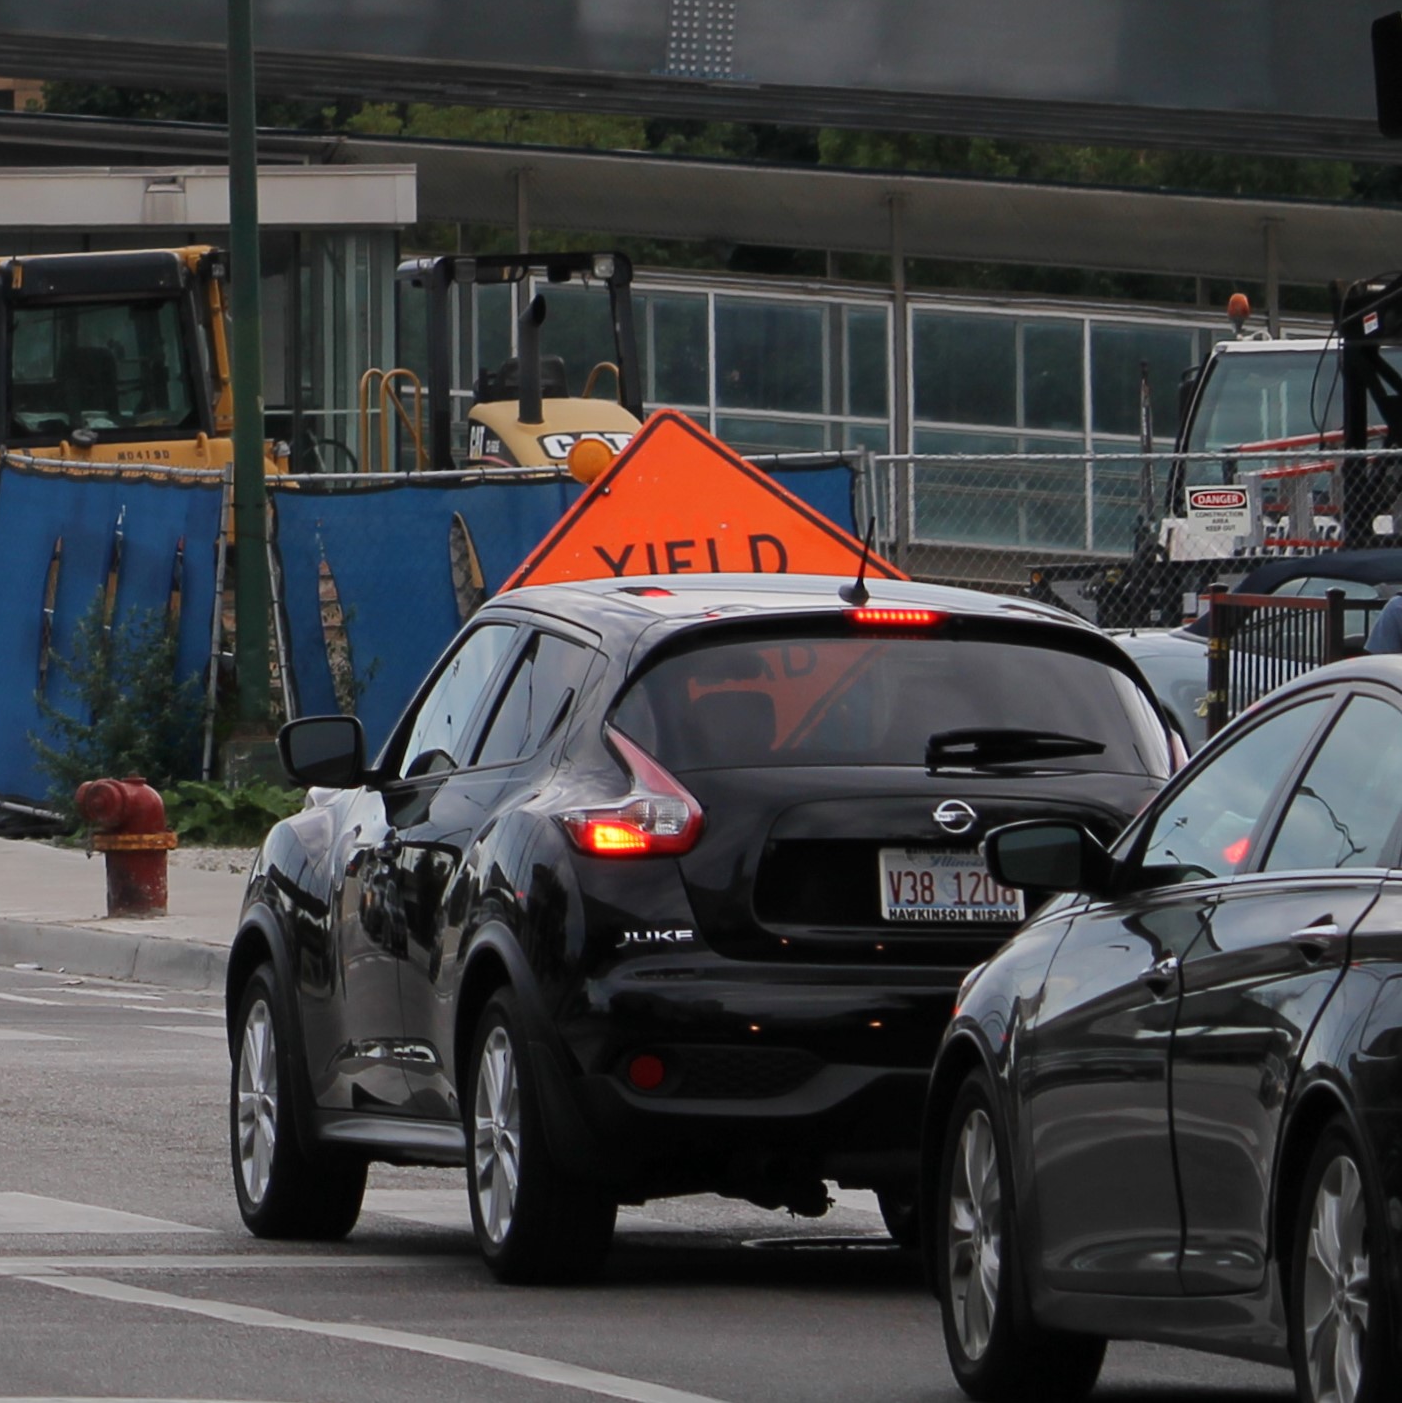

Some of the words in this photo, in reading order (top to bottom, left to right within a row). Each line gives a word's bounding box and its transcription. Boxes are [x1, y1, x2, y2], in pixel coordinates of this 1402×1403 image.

[1198, 494, 1238, 504] DANGER
[889, 871, 935, 905] V38
[889, 909, 967, 920] HAWKINSON
[972, 909, 1019, 920] NISSAN
[615, 930, 693, 948] JUKE
